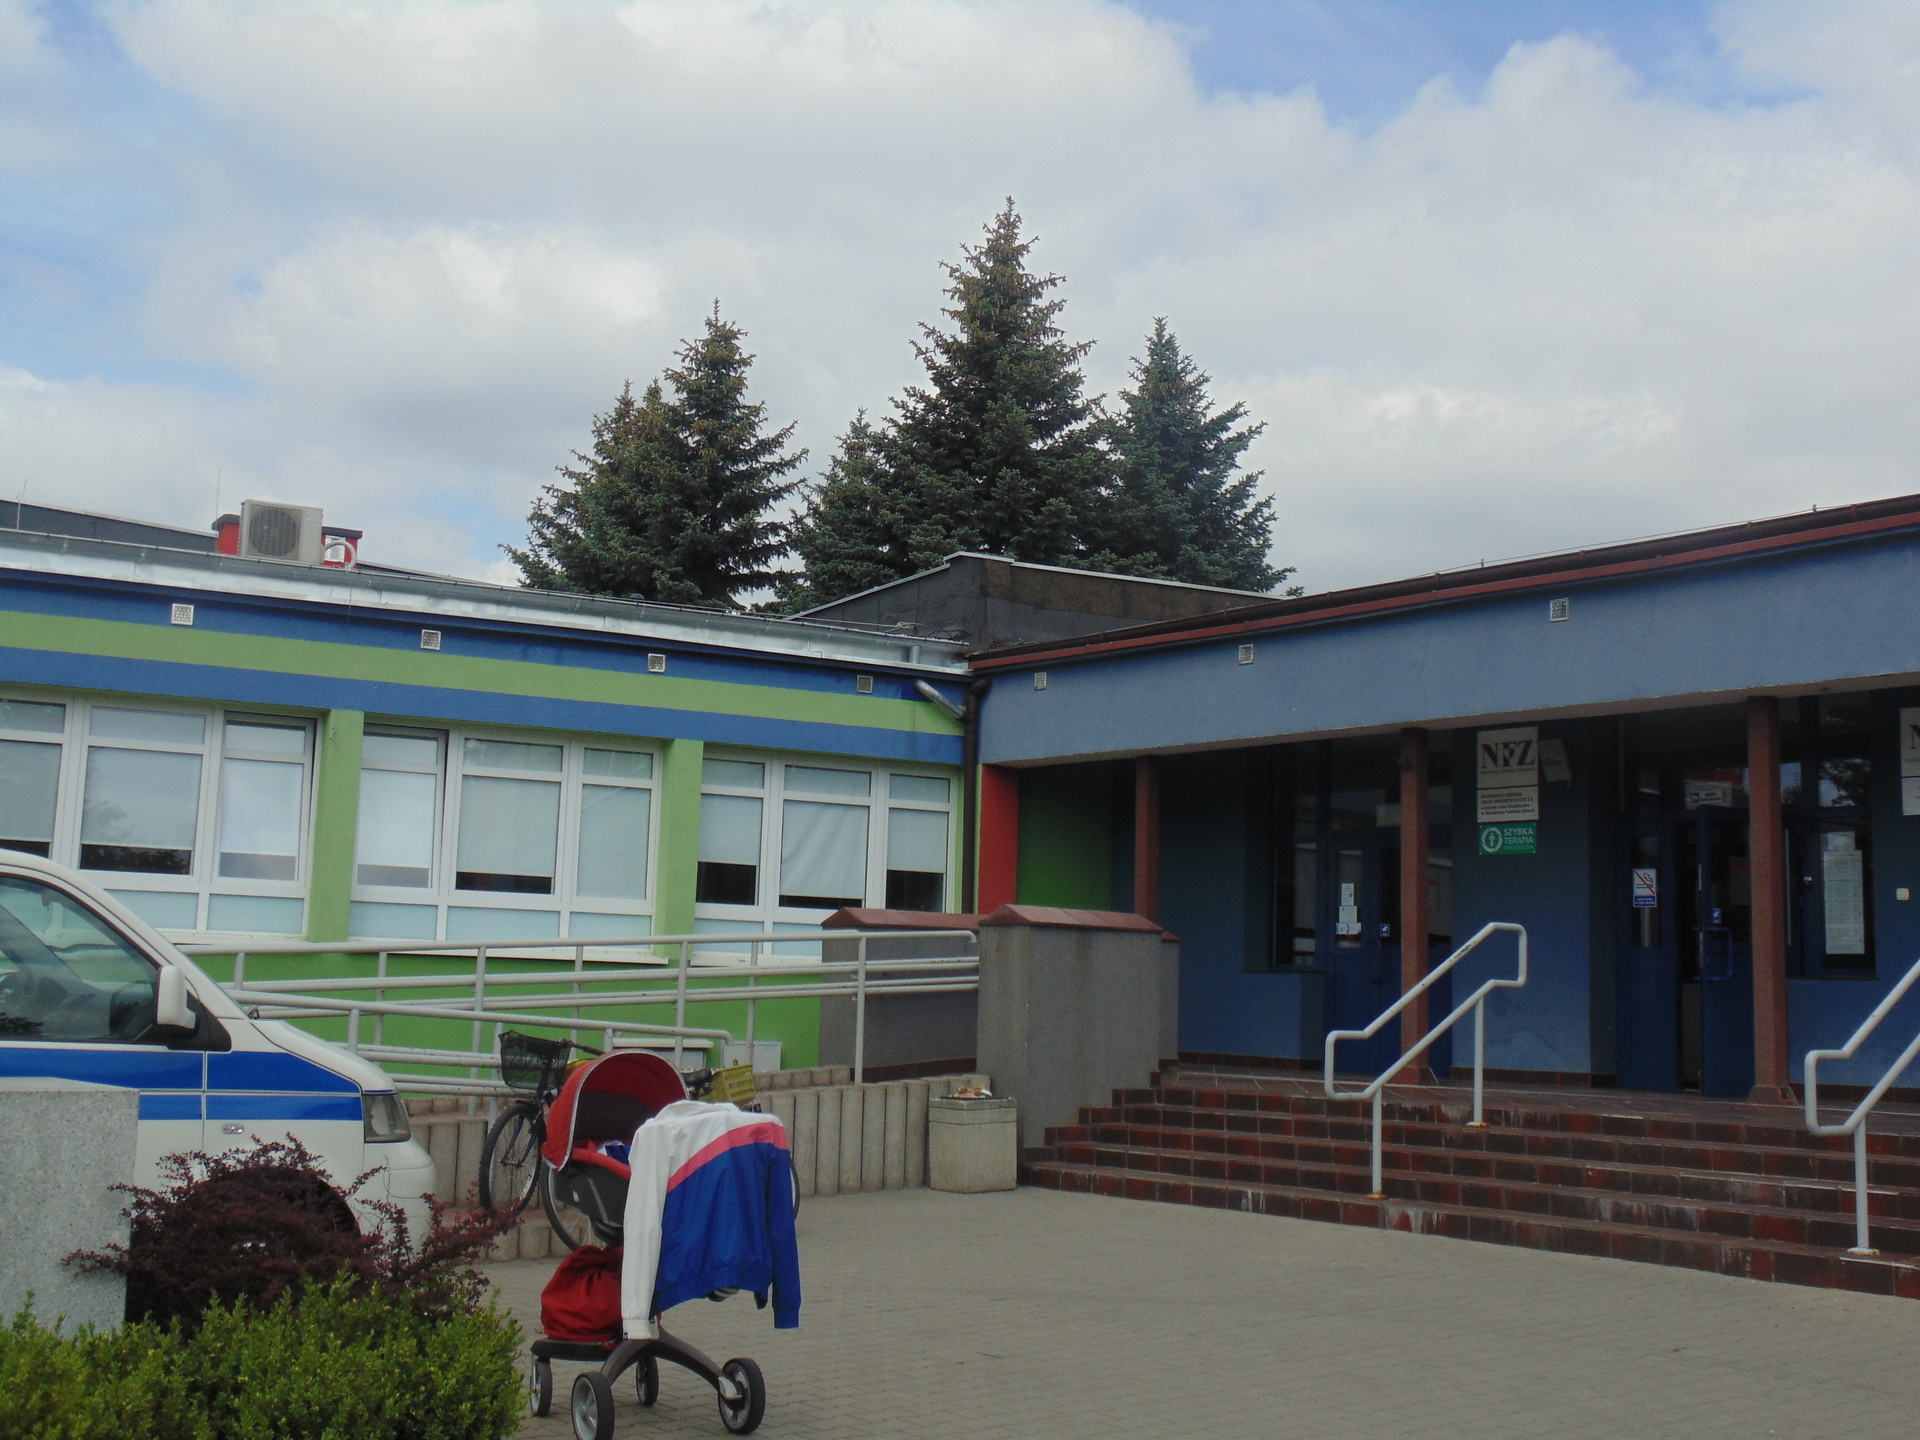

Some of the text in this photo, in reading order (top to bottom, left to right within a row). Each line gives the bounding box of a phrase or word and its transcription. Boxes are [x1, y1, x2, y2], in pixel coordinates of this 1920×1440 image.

[1481, 740, 1535, 769] NFZ
[1504, 828, 1533, 836] SZYBKA
[1504, 837, 1533, 845] TERAPIA
